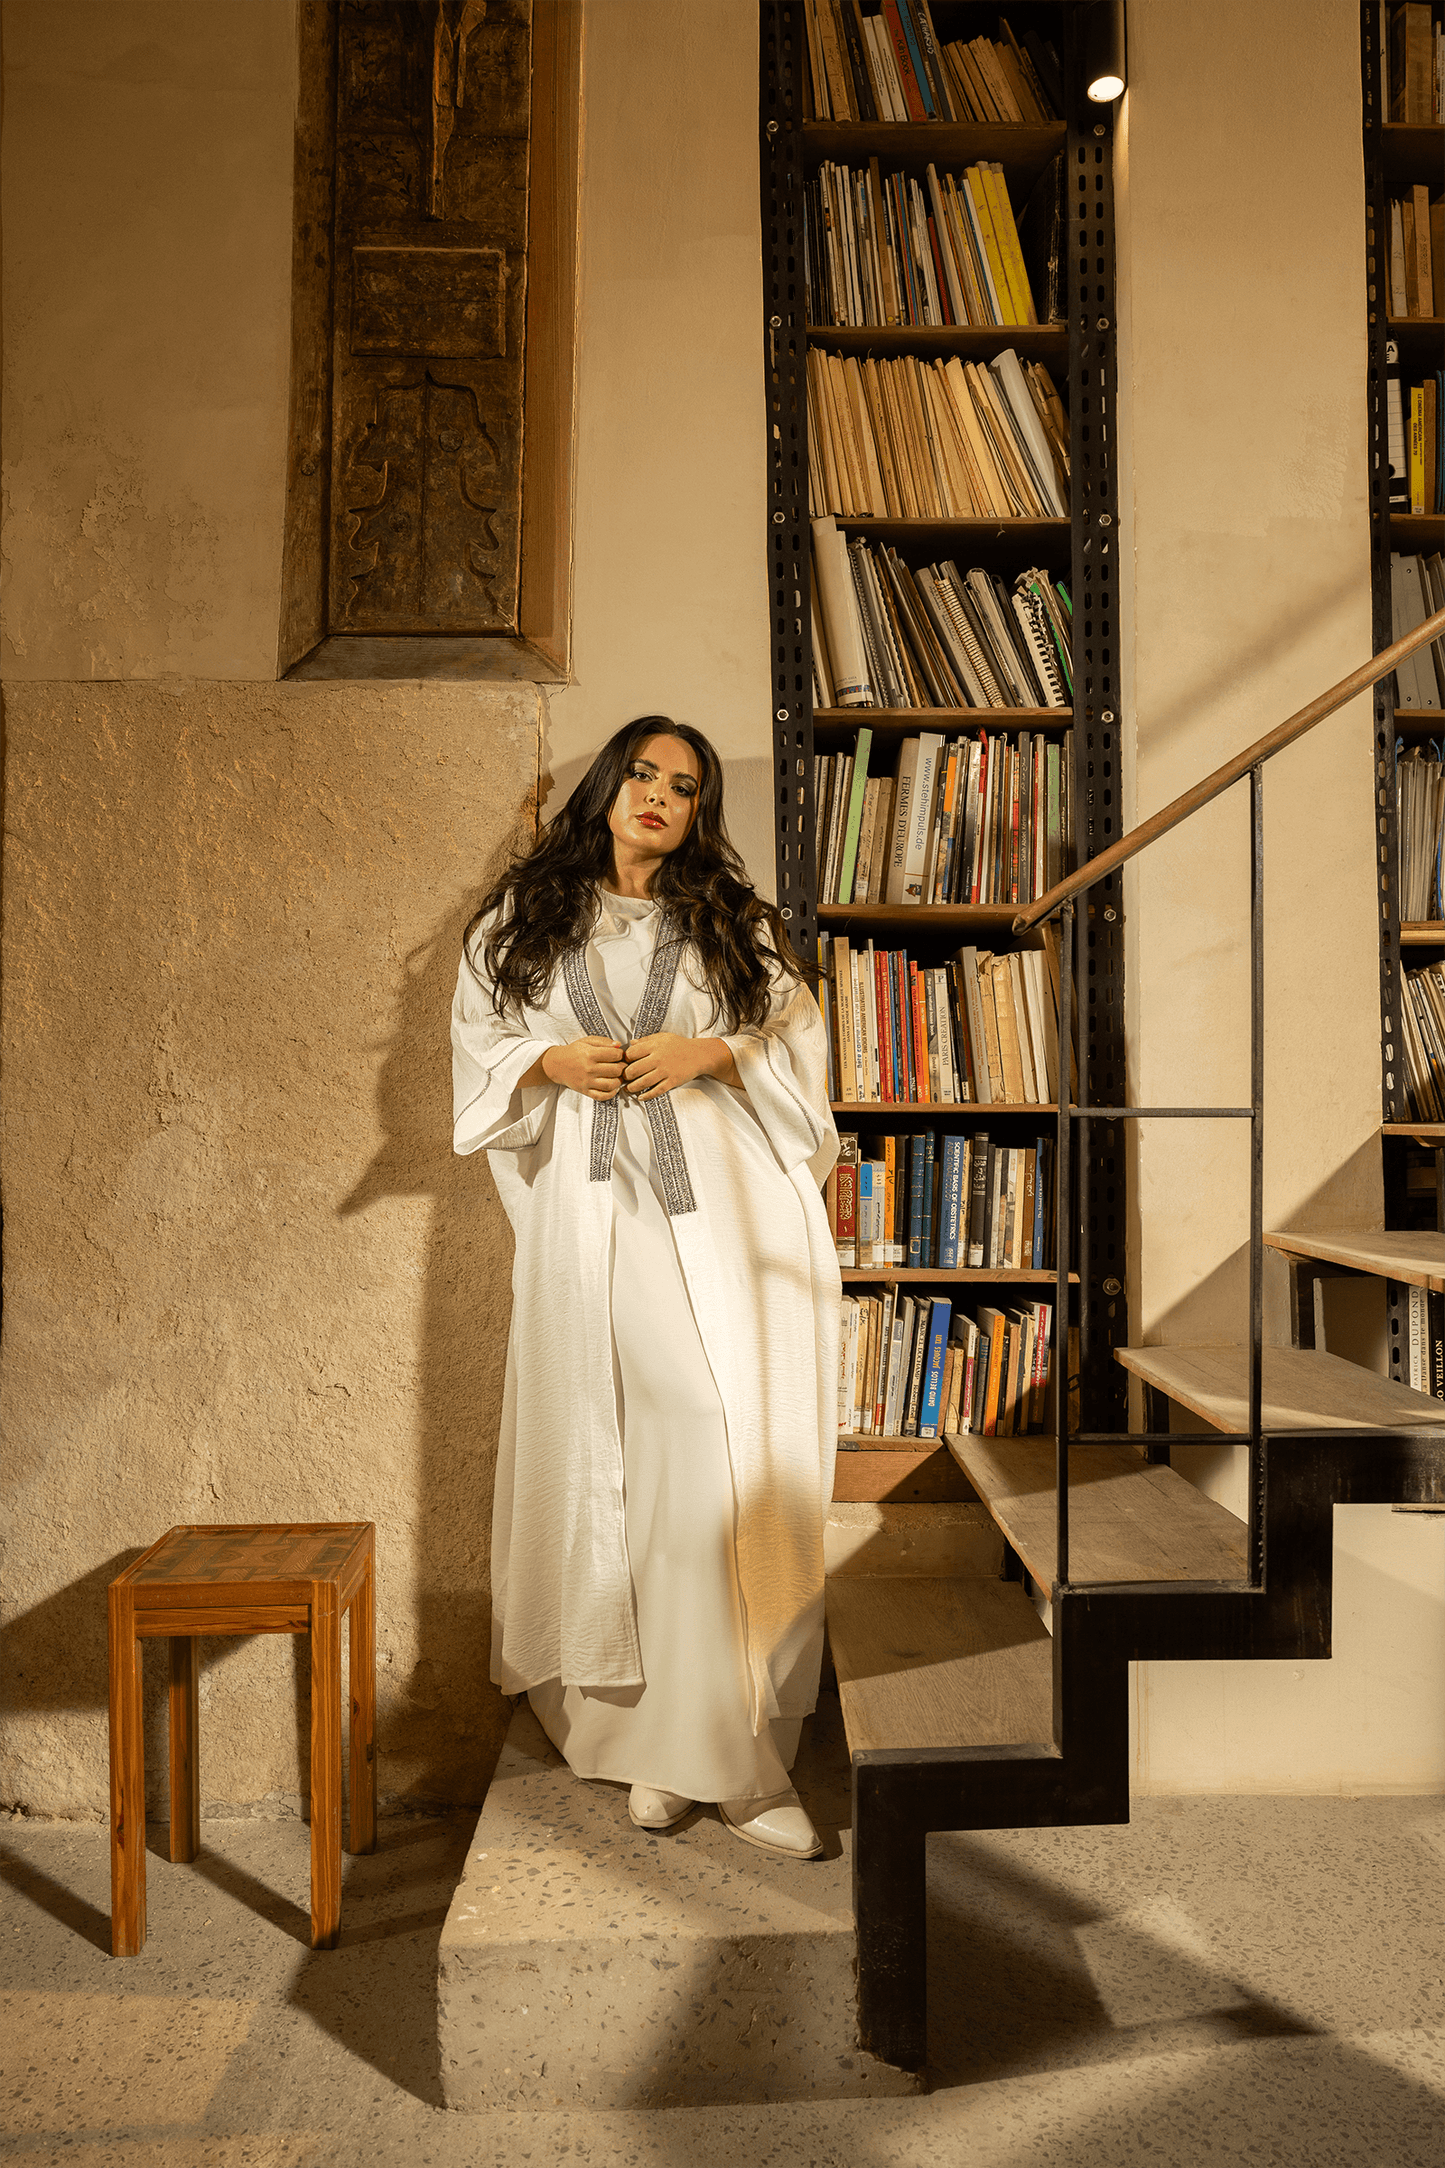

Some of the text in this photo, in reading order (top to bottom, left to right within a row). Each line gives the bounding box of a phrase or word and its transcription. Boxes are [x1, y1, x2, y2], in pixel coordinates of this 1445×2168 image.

[915, 758, 933, 850] www.stehimpuls.de
[894, 776, 911, 868] FERMES D'EUROPE
[939, 1007, 947, 1043] CREATION
[953, 1141, 961, 1174] SCIENTIFIC
[951, 1193, 958, 1202] OF
[949, 1203, 957, 1240] OBSTETRICS
[918, 1320, 927, 1346] MARCEL
[1411, 1290, 1420, 1346] DUPOND
[914, 1347, 923, 1380] DUCHAMP
[932, 1347, 942, 1369] JACQUES
[1435, 1340, 1444, 1401] O VEILLON
[930, 1371, 939, 1390] BELLOS
[928, 1391, 937, 1407] DAVID
